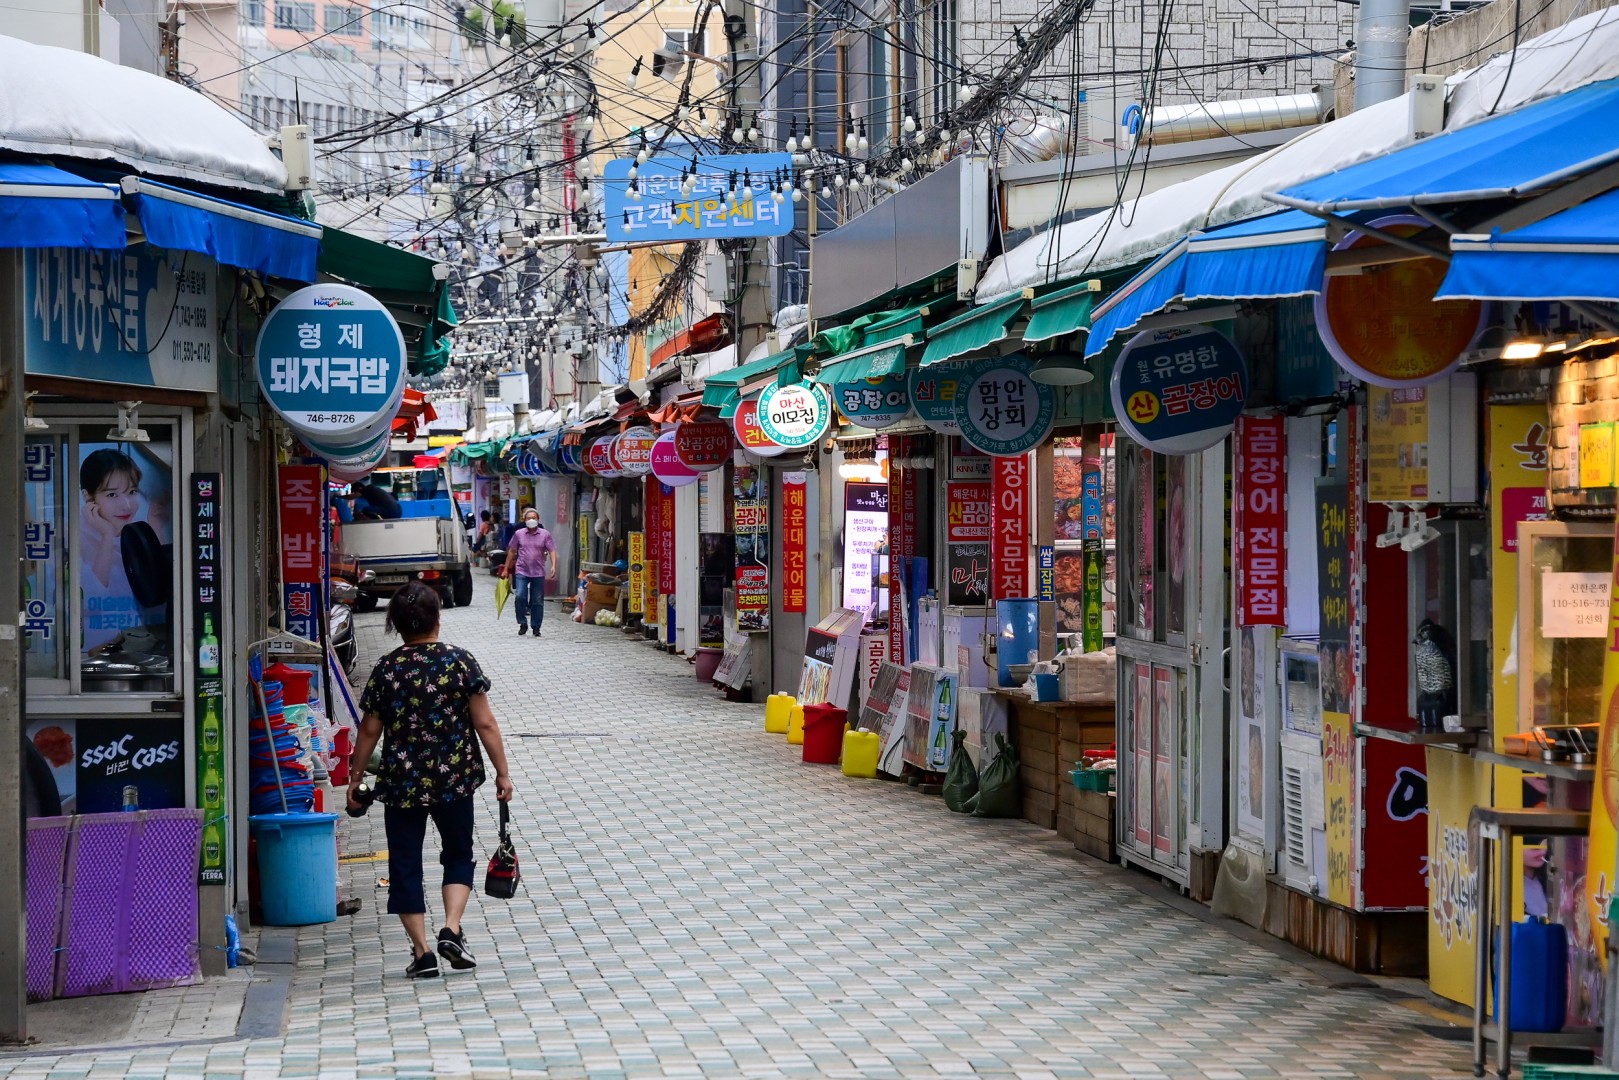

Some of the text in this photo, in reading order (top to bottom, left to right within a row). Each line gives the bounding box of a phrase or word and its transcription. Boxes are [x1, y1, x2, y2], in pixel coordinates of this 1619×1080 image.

[620, 199, 780, 230] 고객지원센터
[1153, 345, 1219, 379] 유명한
[270, 357, 390, 394] 돼지국밥
[780, 397, 805, 409] 마산
[978, 379, 1027, 404] 함안
[1161, 372, 1245, 417] 곰장어
[307, 414, 355, 423] 746-8726
[772, 408, 814, 425] 이모집
[979, 404, 1026, 430] 상회
[1131, 393, 1154, 419] 산
[679, 436, 728, 452] 산곰장어
[953, 488, 978, 499] 해운대
[282, 479, 316, 569] 족발
[736, 507, 767, 525] 곰장어
[790, 489, 805, 545] 해운대
[949, 501, 989, 524] 산곰장
[1249, 425, 1279, 616] 곰장어 전문점
[959, 527, 978, 536] 국내산
[1000, 456, 1026, 599] 장어전문점
[197, 480, 216, 603] 형제돼지국밥
[1040, 548, 1053, 567] 쌀
[632, 573, 642, 611] 연탄구이
[790, 551, 805, 607] 건어물
[1040, 569, 1053, 599] 잡곡
[1570, 583, 1608, 593] 신한은행
[738, 594, 768, 605] 추천맛집
[201, 872, 224, 880] TERRA
